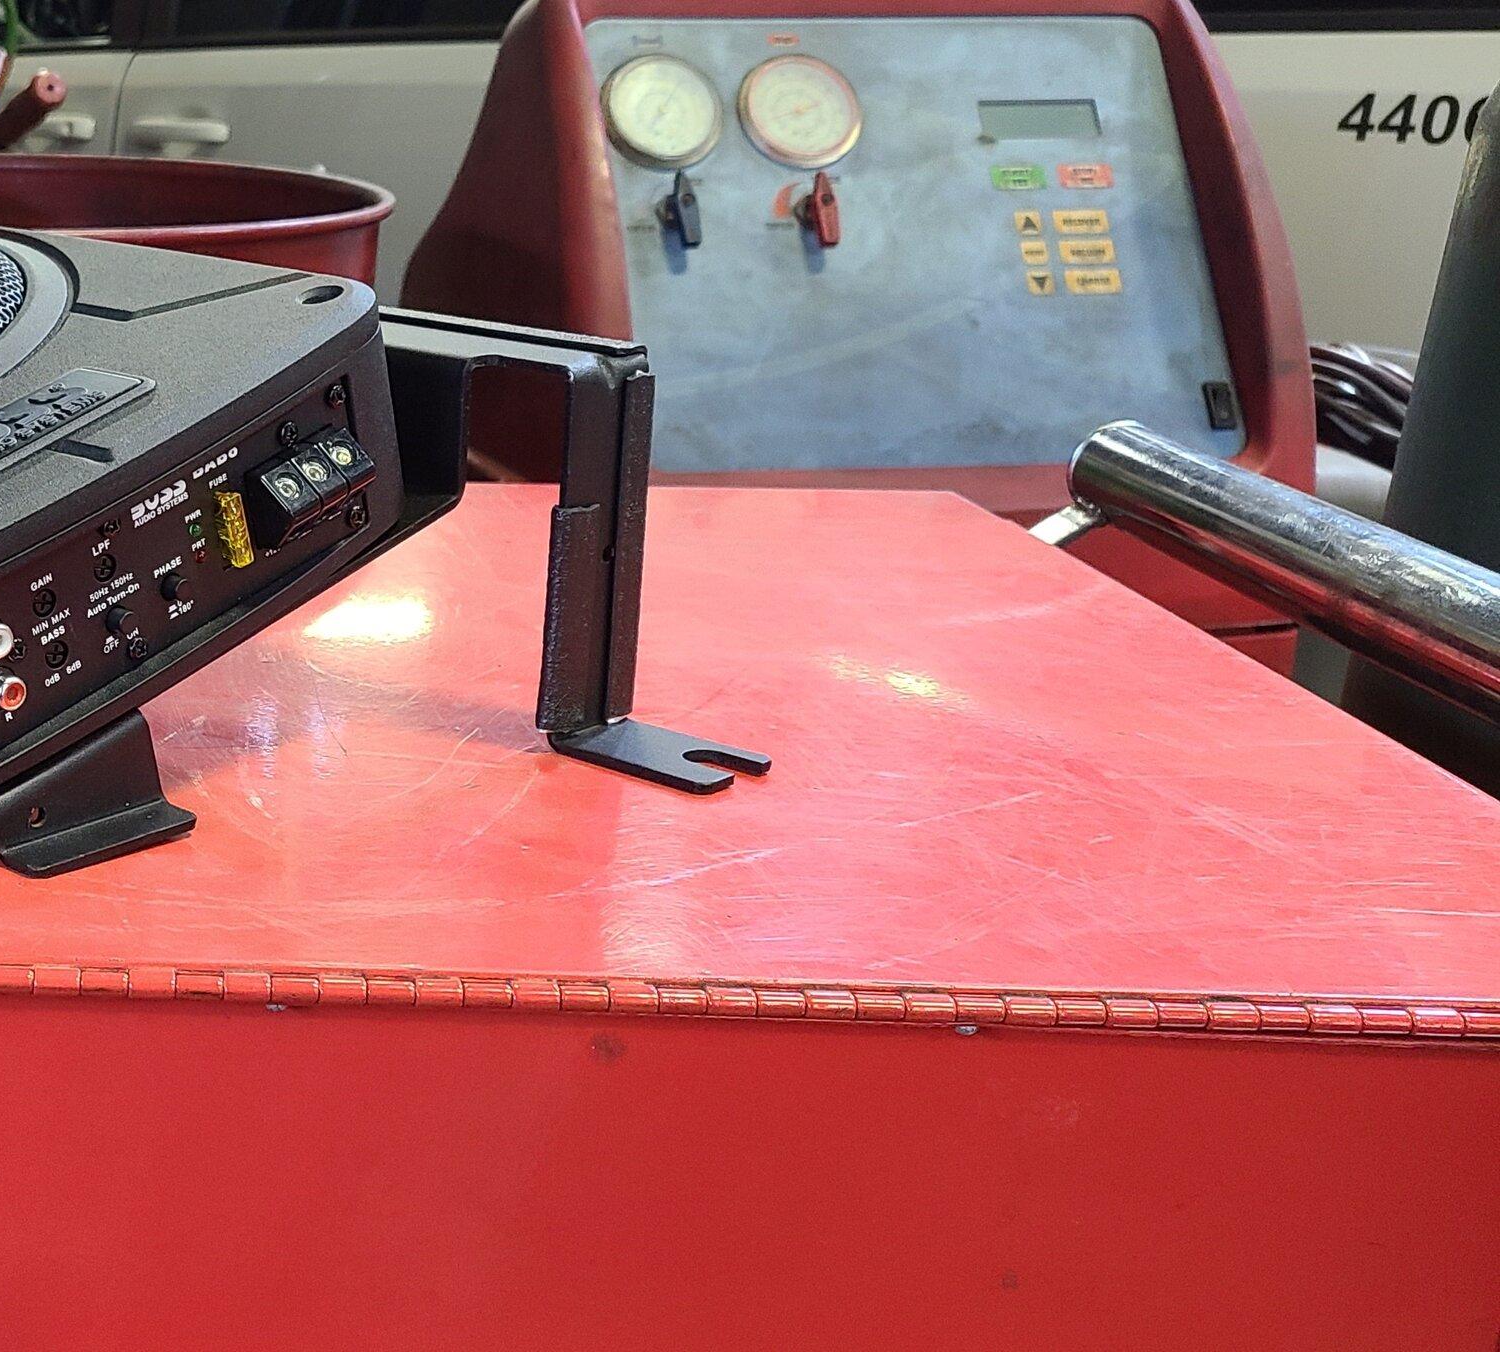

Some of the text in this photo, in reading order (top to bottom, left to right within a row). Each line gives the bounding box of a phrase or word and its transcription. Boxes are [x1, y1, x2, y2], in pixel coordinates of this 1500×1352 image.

[14, 389, 108, 440] SYSTEMS
[208, 473, 228, 489] FUSE
[134, 491, 189, 528] AUDIO SYSTEMS
[184, 508, 202, 524] PWR
[92, 538, 111, 557] LPF
[191, 537, 206, 551] PRT
[153, 556, 183, 578] PHASE
[30, 573, 53, 591] GAIN
[89, 572, 134, 603] 50Hz 150Hz
[87, 582, 140, 618] Auto Turn-On
[32, 607, 72, 636] MIN MAX
[40, 625, 66, 645] BASS
[103, 638, 120, 654] OFF
[44, 659, 82, 687] 0dB 6dB
[4, 711, 13, 722] R
